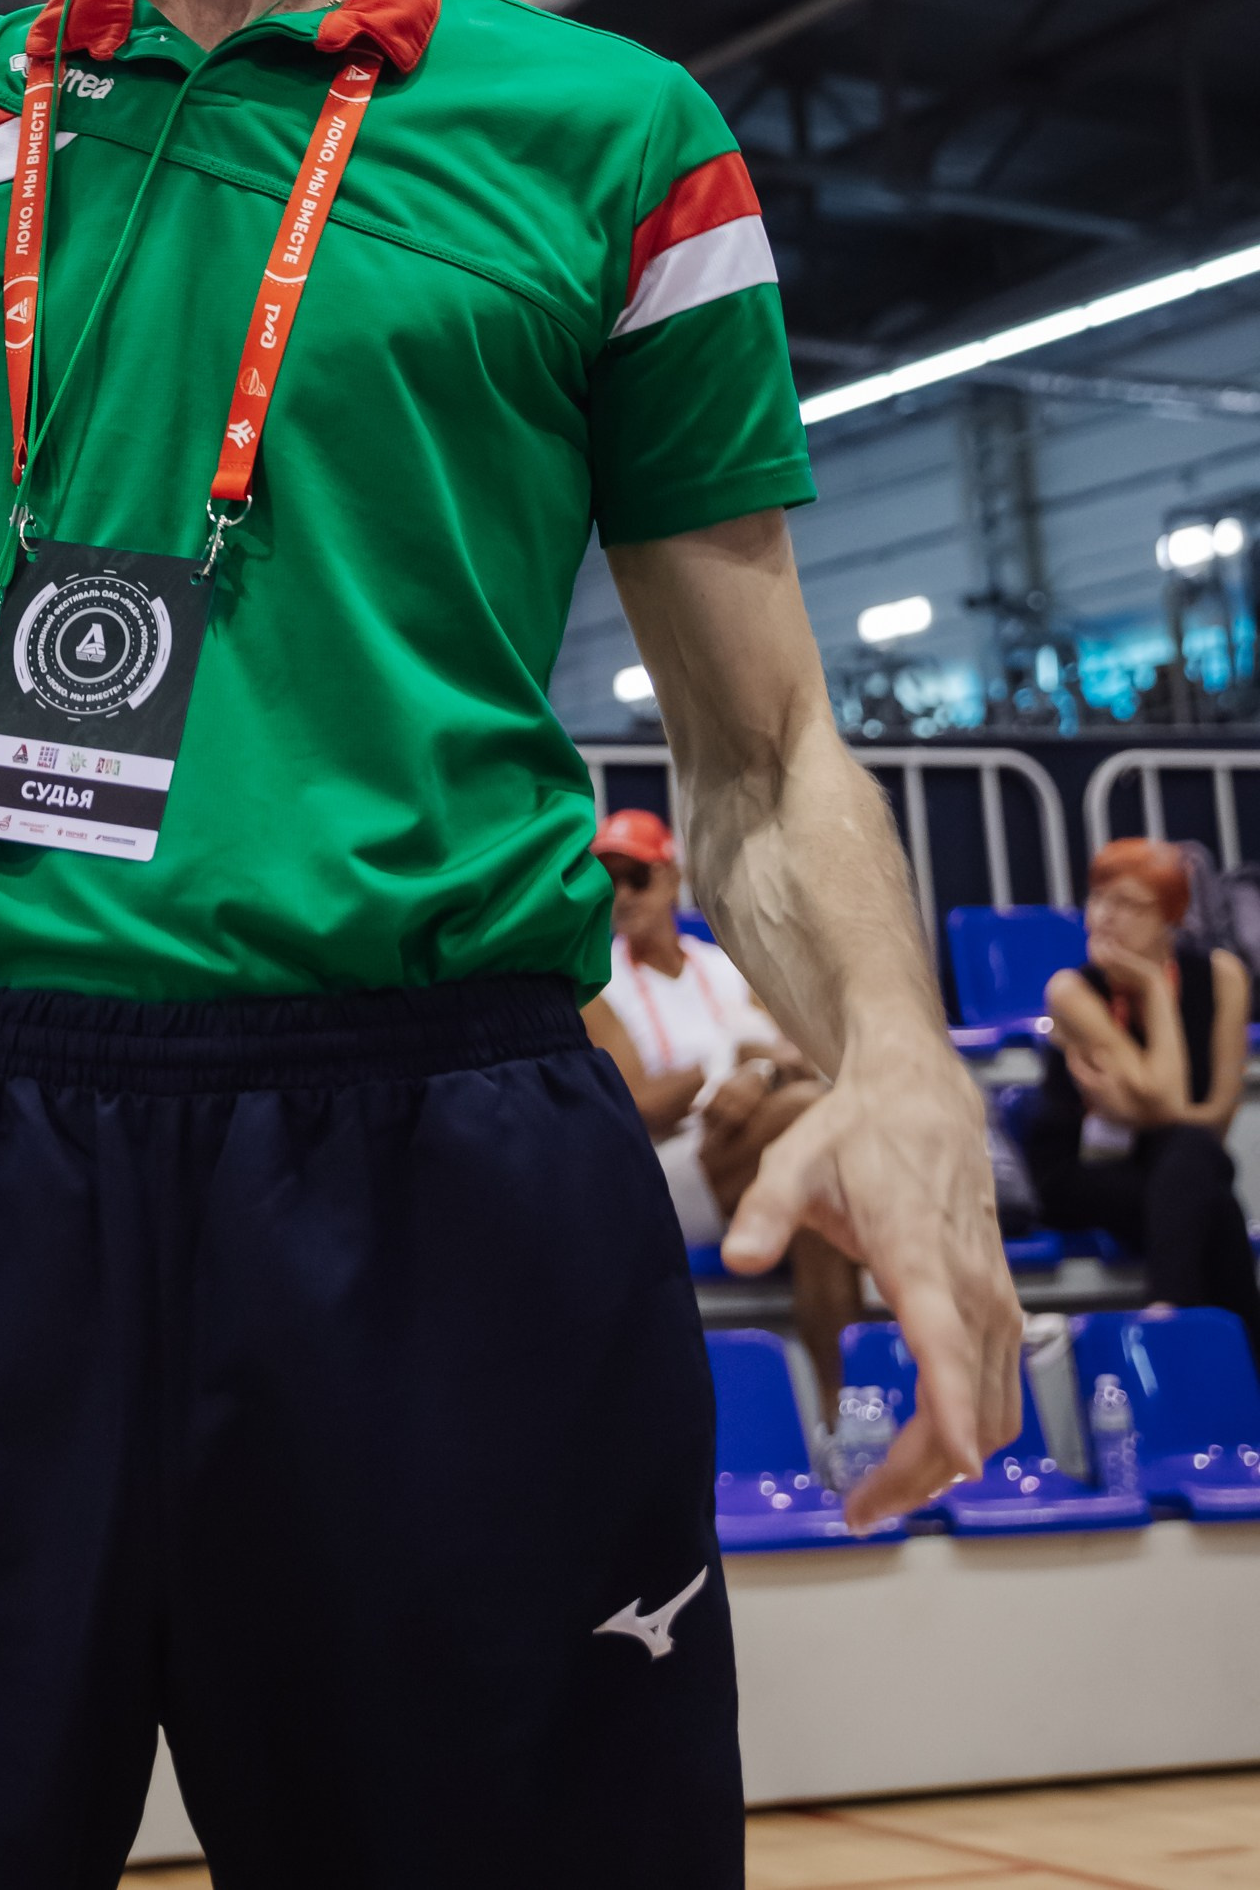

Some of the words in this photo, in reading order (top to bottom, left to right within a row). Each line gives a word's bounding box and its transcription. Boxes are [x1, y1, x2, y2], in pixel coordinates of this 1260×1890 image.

[26, 101, 48, 166] ВМЕСТЕ
[22, 169, 38, 198] МЫ
[308, 167, 330, 197] МЫ
[16, 202, 35, 255] ЛОКО.
[283, 199, 319, 265] ВМЕСТЕ
[37, 613, 56, 674] СПОРТИВНЫЙ
[53, 589, 101, 616] ФЕСТИВАЛЬ
[101, 589, 120, 601] ОАО
[124, 625, 148, 686] РОСПРОФЖЕЛ
[69, 691, 85, 702] МЫ
[21, 780, 95, 809] СУДЬЯ
